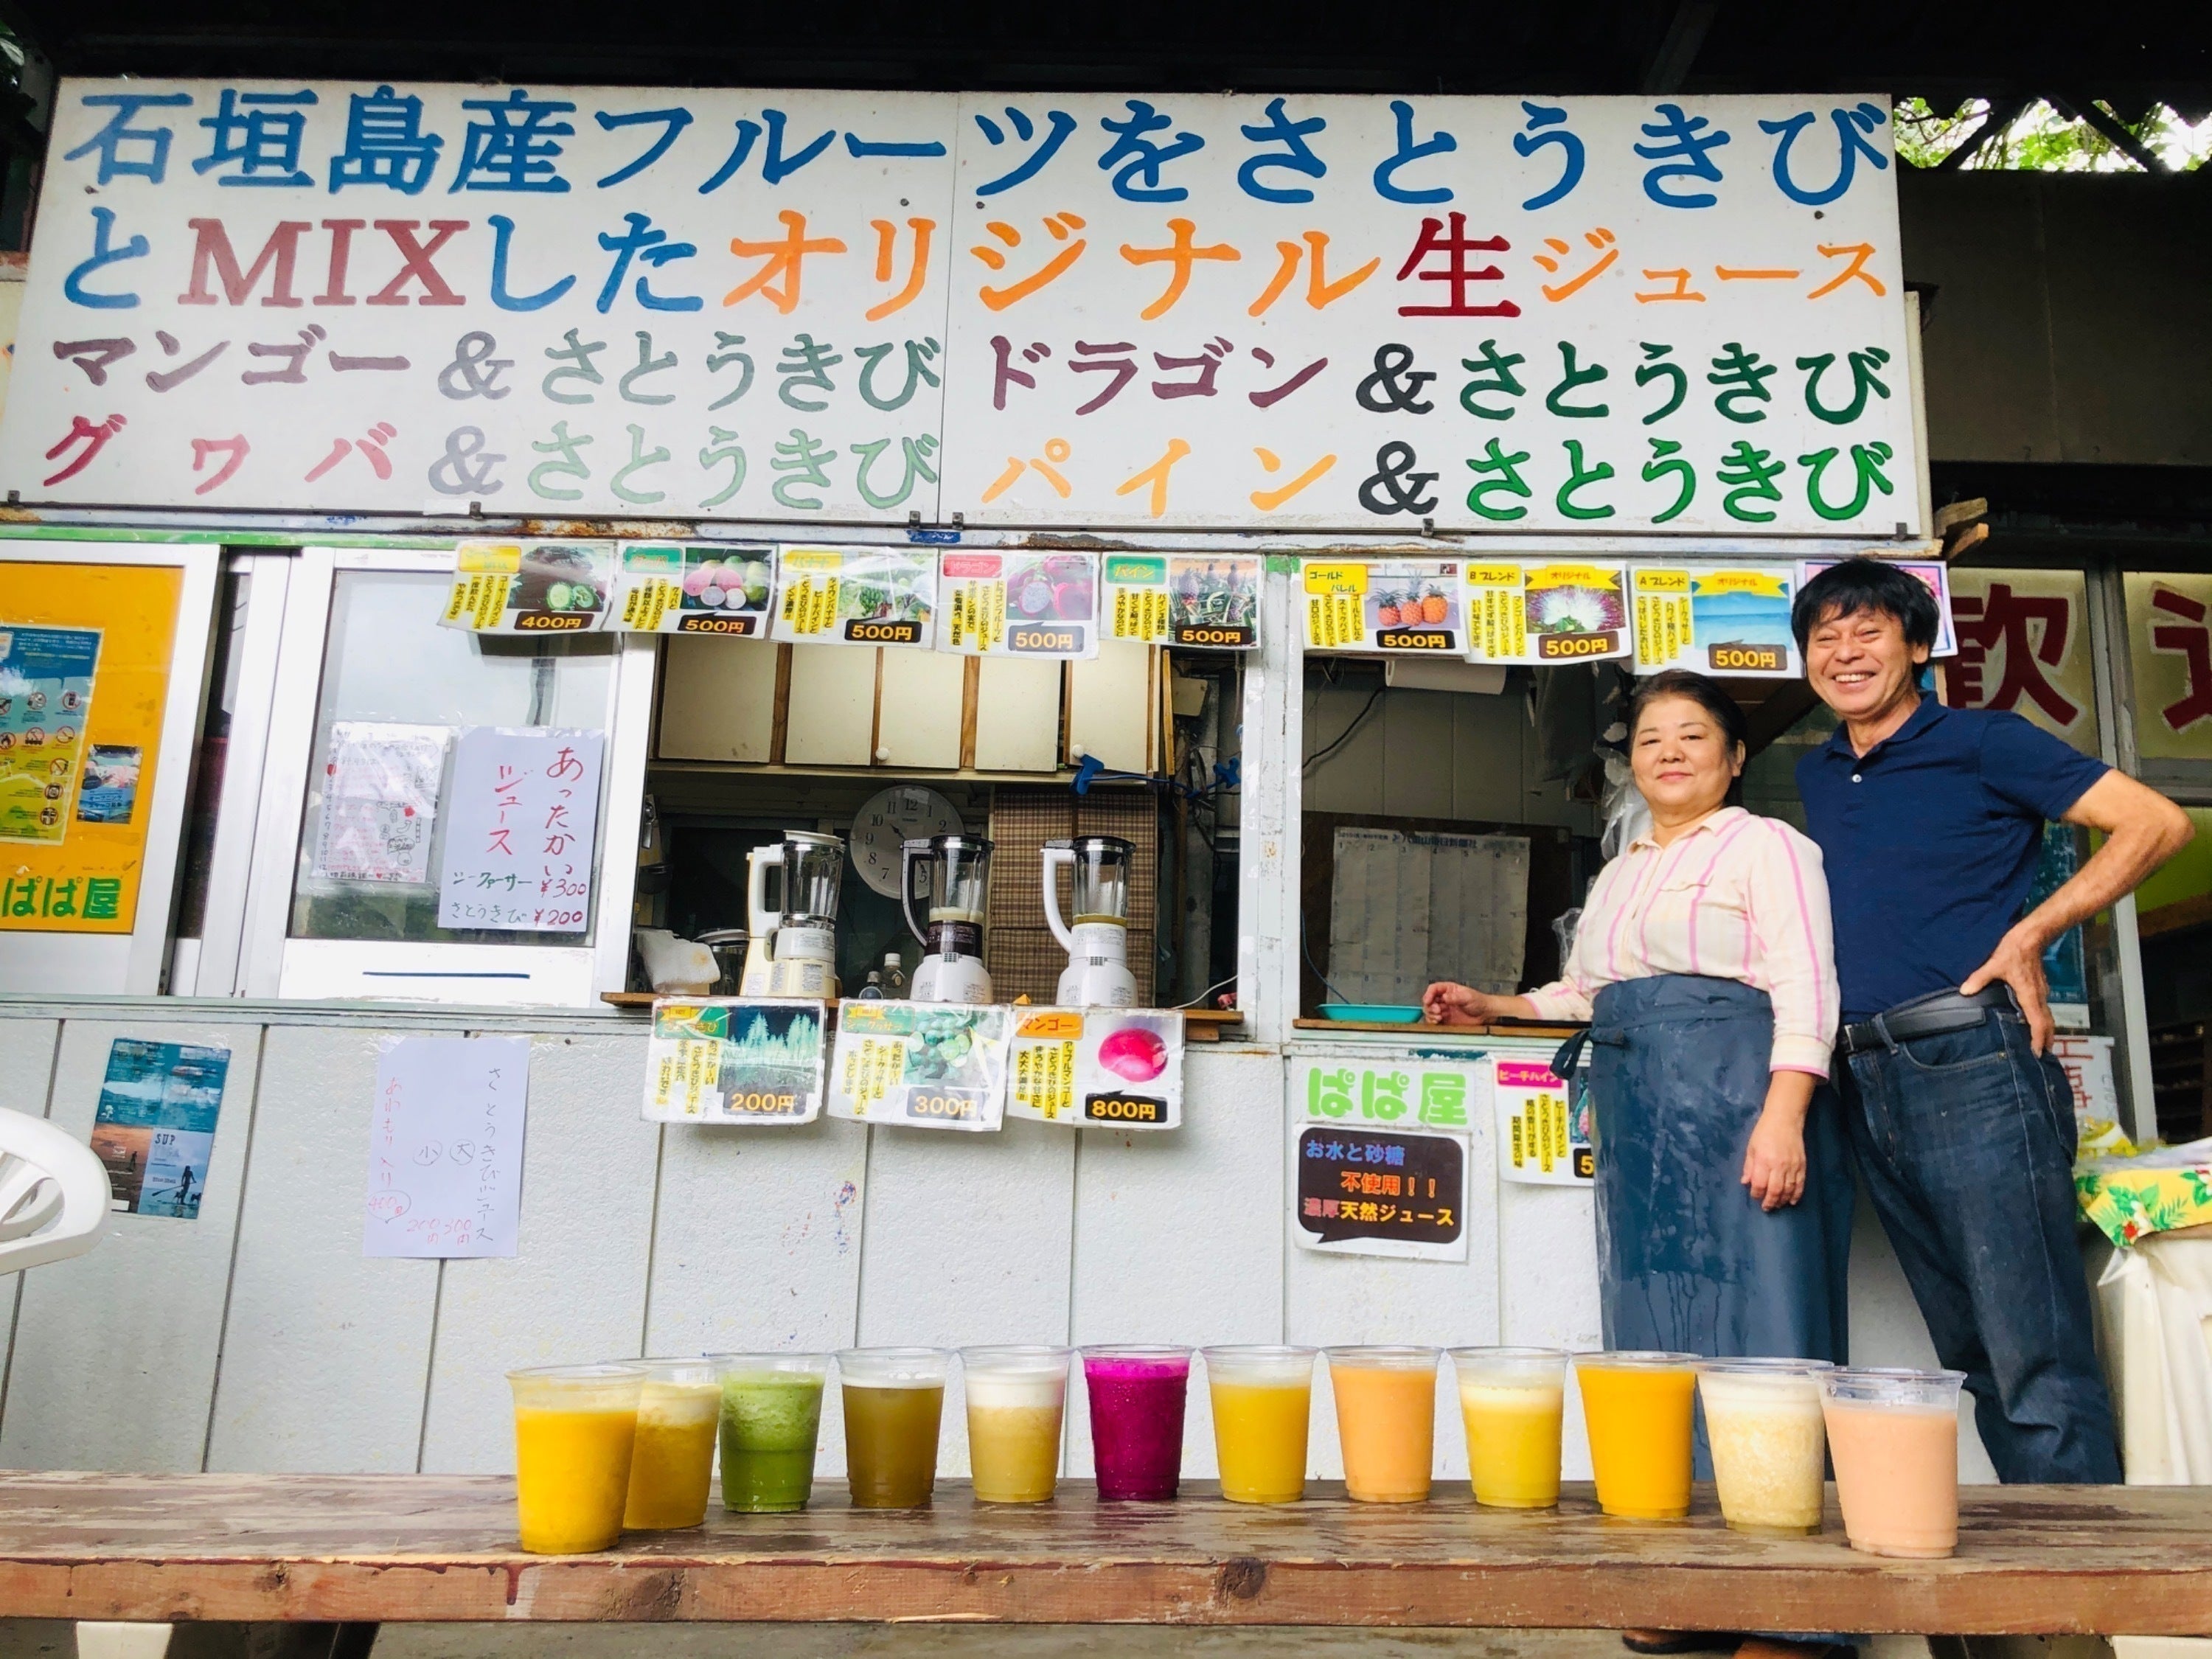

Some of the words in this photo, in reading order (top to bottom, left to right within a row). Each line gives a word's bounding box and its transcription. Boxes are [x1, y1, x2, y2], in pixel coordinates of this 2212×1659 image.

[63, 86, 1890, 211] 石垣島産フルーツをさとうきび
[950, 560, 995, 575] ドラゴン
[1115, 563, 1154, 579] パイン
[1310, 571, 1343, 580] ゴールド
[1551, 571, 1591, 580] オリジナル
[1717, 577, 1758, 586] オリジナル
[521, 616, 582, 628] 400円
[685, 619, 745, 633] 500円
[852, 625, 913, 641] 500円
[1182, 630, 1241, 643] 500円
[1015, 633, 1074, 649] 500円
[1384, 634, 1446, 648] 500円
[1545, 638, 1608, 655] 500円
[1715, 650, 1777, 668] 500円
[486, 765, 534, 855] ジュース
[543, 747, 584, 876] あったかい
[887, 801, 896, 813] 11
[905, 799, 918, 810] 12
[927, 805, 932, 818] 1
[872, 814, 883, 827] 10
[938, 820, 947, 832] 2
[865, 832, 874, 845] 9
[868, 852, 877, 865] 8
[881, 868, 889, 880] 7
[1, 876, 122, 919] ぱぱ屋
[451, 901, 527, 925] さとうきび
[1022, 1018, 1073, 1032] マンゴー
[1061, 1040, 1074, 1108] アップルマンゴーと
[1046, 1046, 1059, 1119] さとうきびのジュース
[731, 1093, 795, 1112] 200円
[1307, 1067, 1469, 1127] ぱぱ屋
[1091, 1099, 1156, 1120] 800円
[155, 1133, 175, 1146] SUP
[1305, 1139, 1406, 1166] お水と砂糖
[1303, 1197, 1455, 1227] 濃厚天然ジュース
